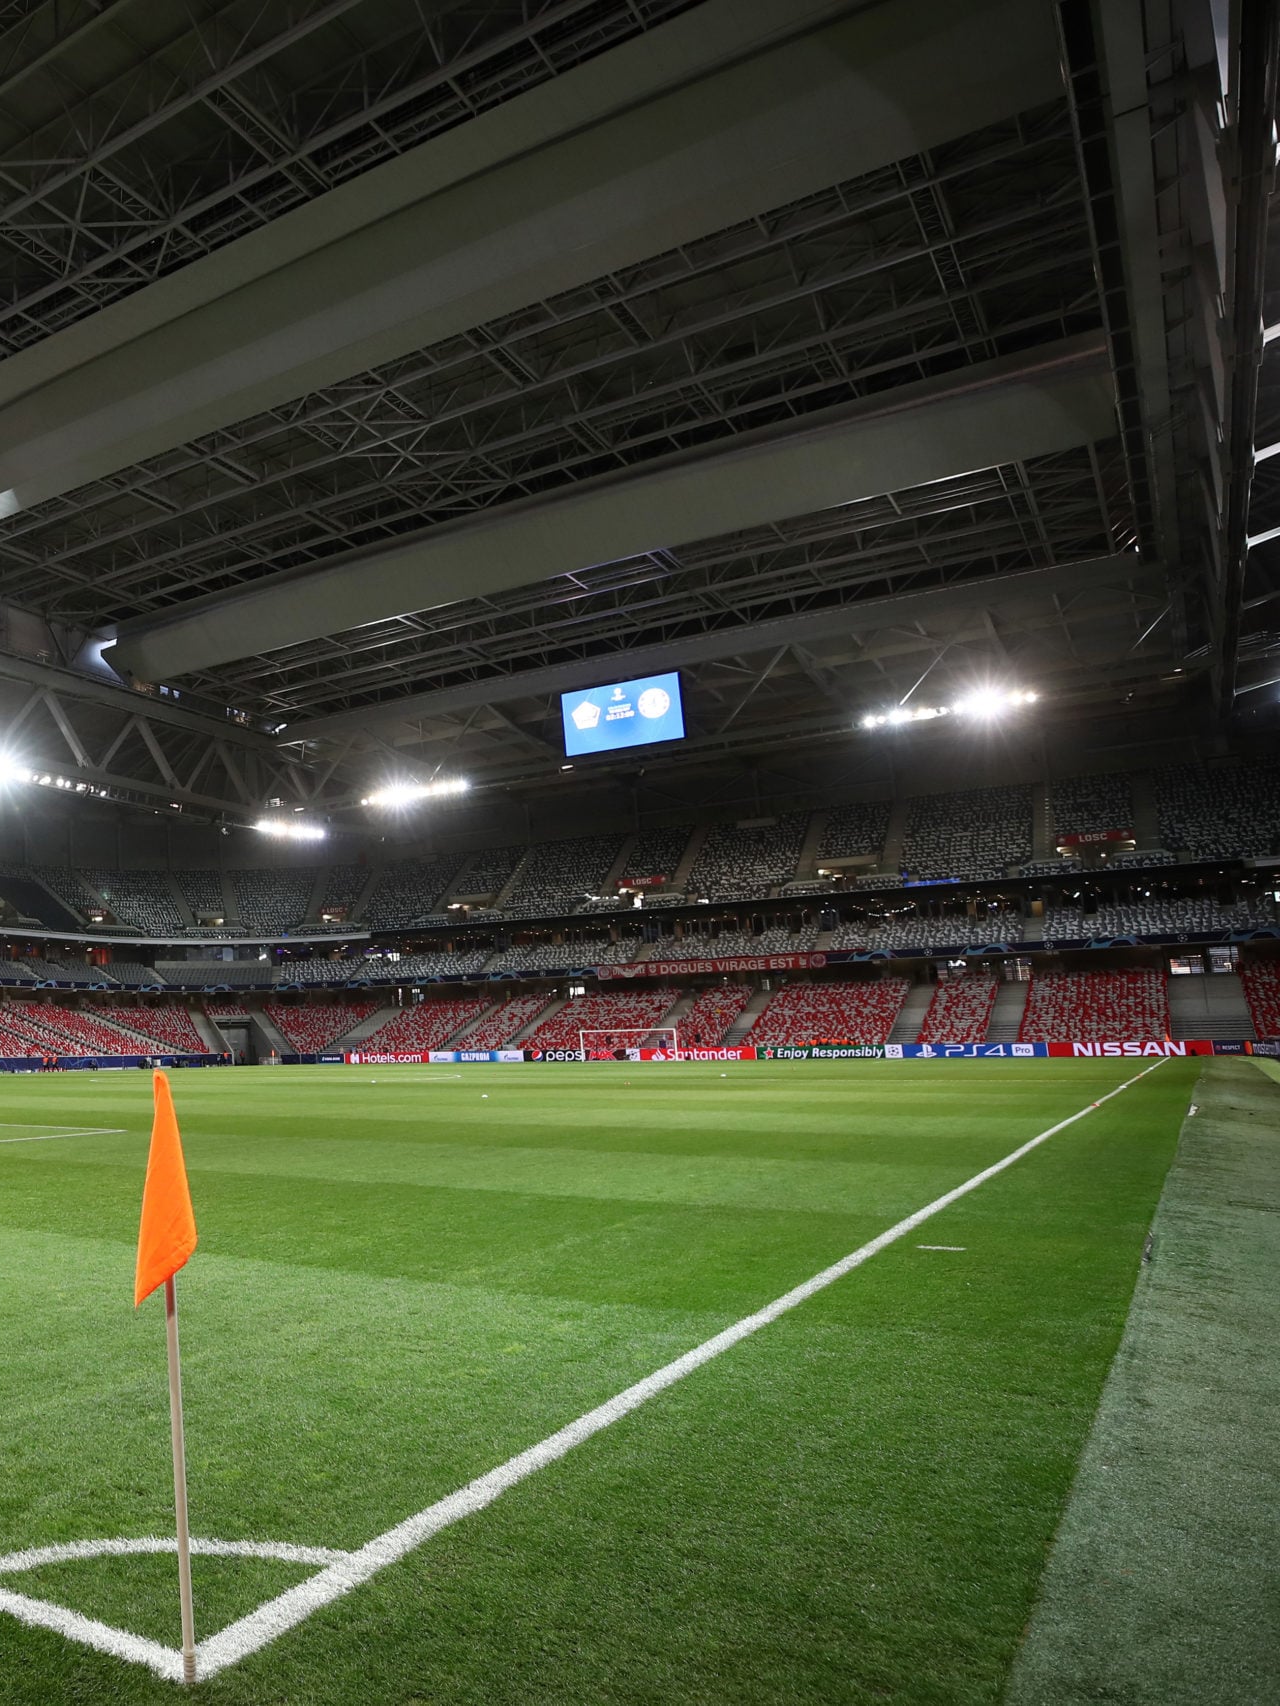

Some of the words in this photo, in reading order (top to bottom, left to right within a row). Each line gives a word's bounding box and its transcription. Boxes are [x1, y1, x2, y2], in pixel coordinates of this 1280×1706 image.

[1078, 832, 1108, 843] LOSC
[632, 877, 652, 885] LOSC
[660, 961, 713, 974] DOGUES
[716, 958, 766, 972] VIRAGE
[770, 957, 795, 969] EST
[589, 1049, 616, 1060] MAX
[667, 1048, 742, 1060] Santander
[777, 1048, 808, 1058] Enjoy
[812, 1046, 884, 1058] Responsibly
[945, 1044, 1007, 1057] PS4
[1015, 1046, 1031, 1054] Pro
[1073, 1042, 1187, 1056] NISSAN
[362, 1053, 422, 1063] Hotels.com
[461, 1052, 490, 1061] GAZPROM
